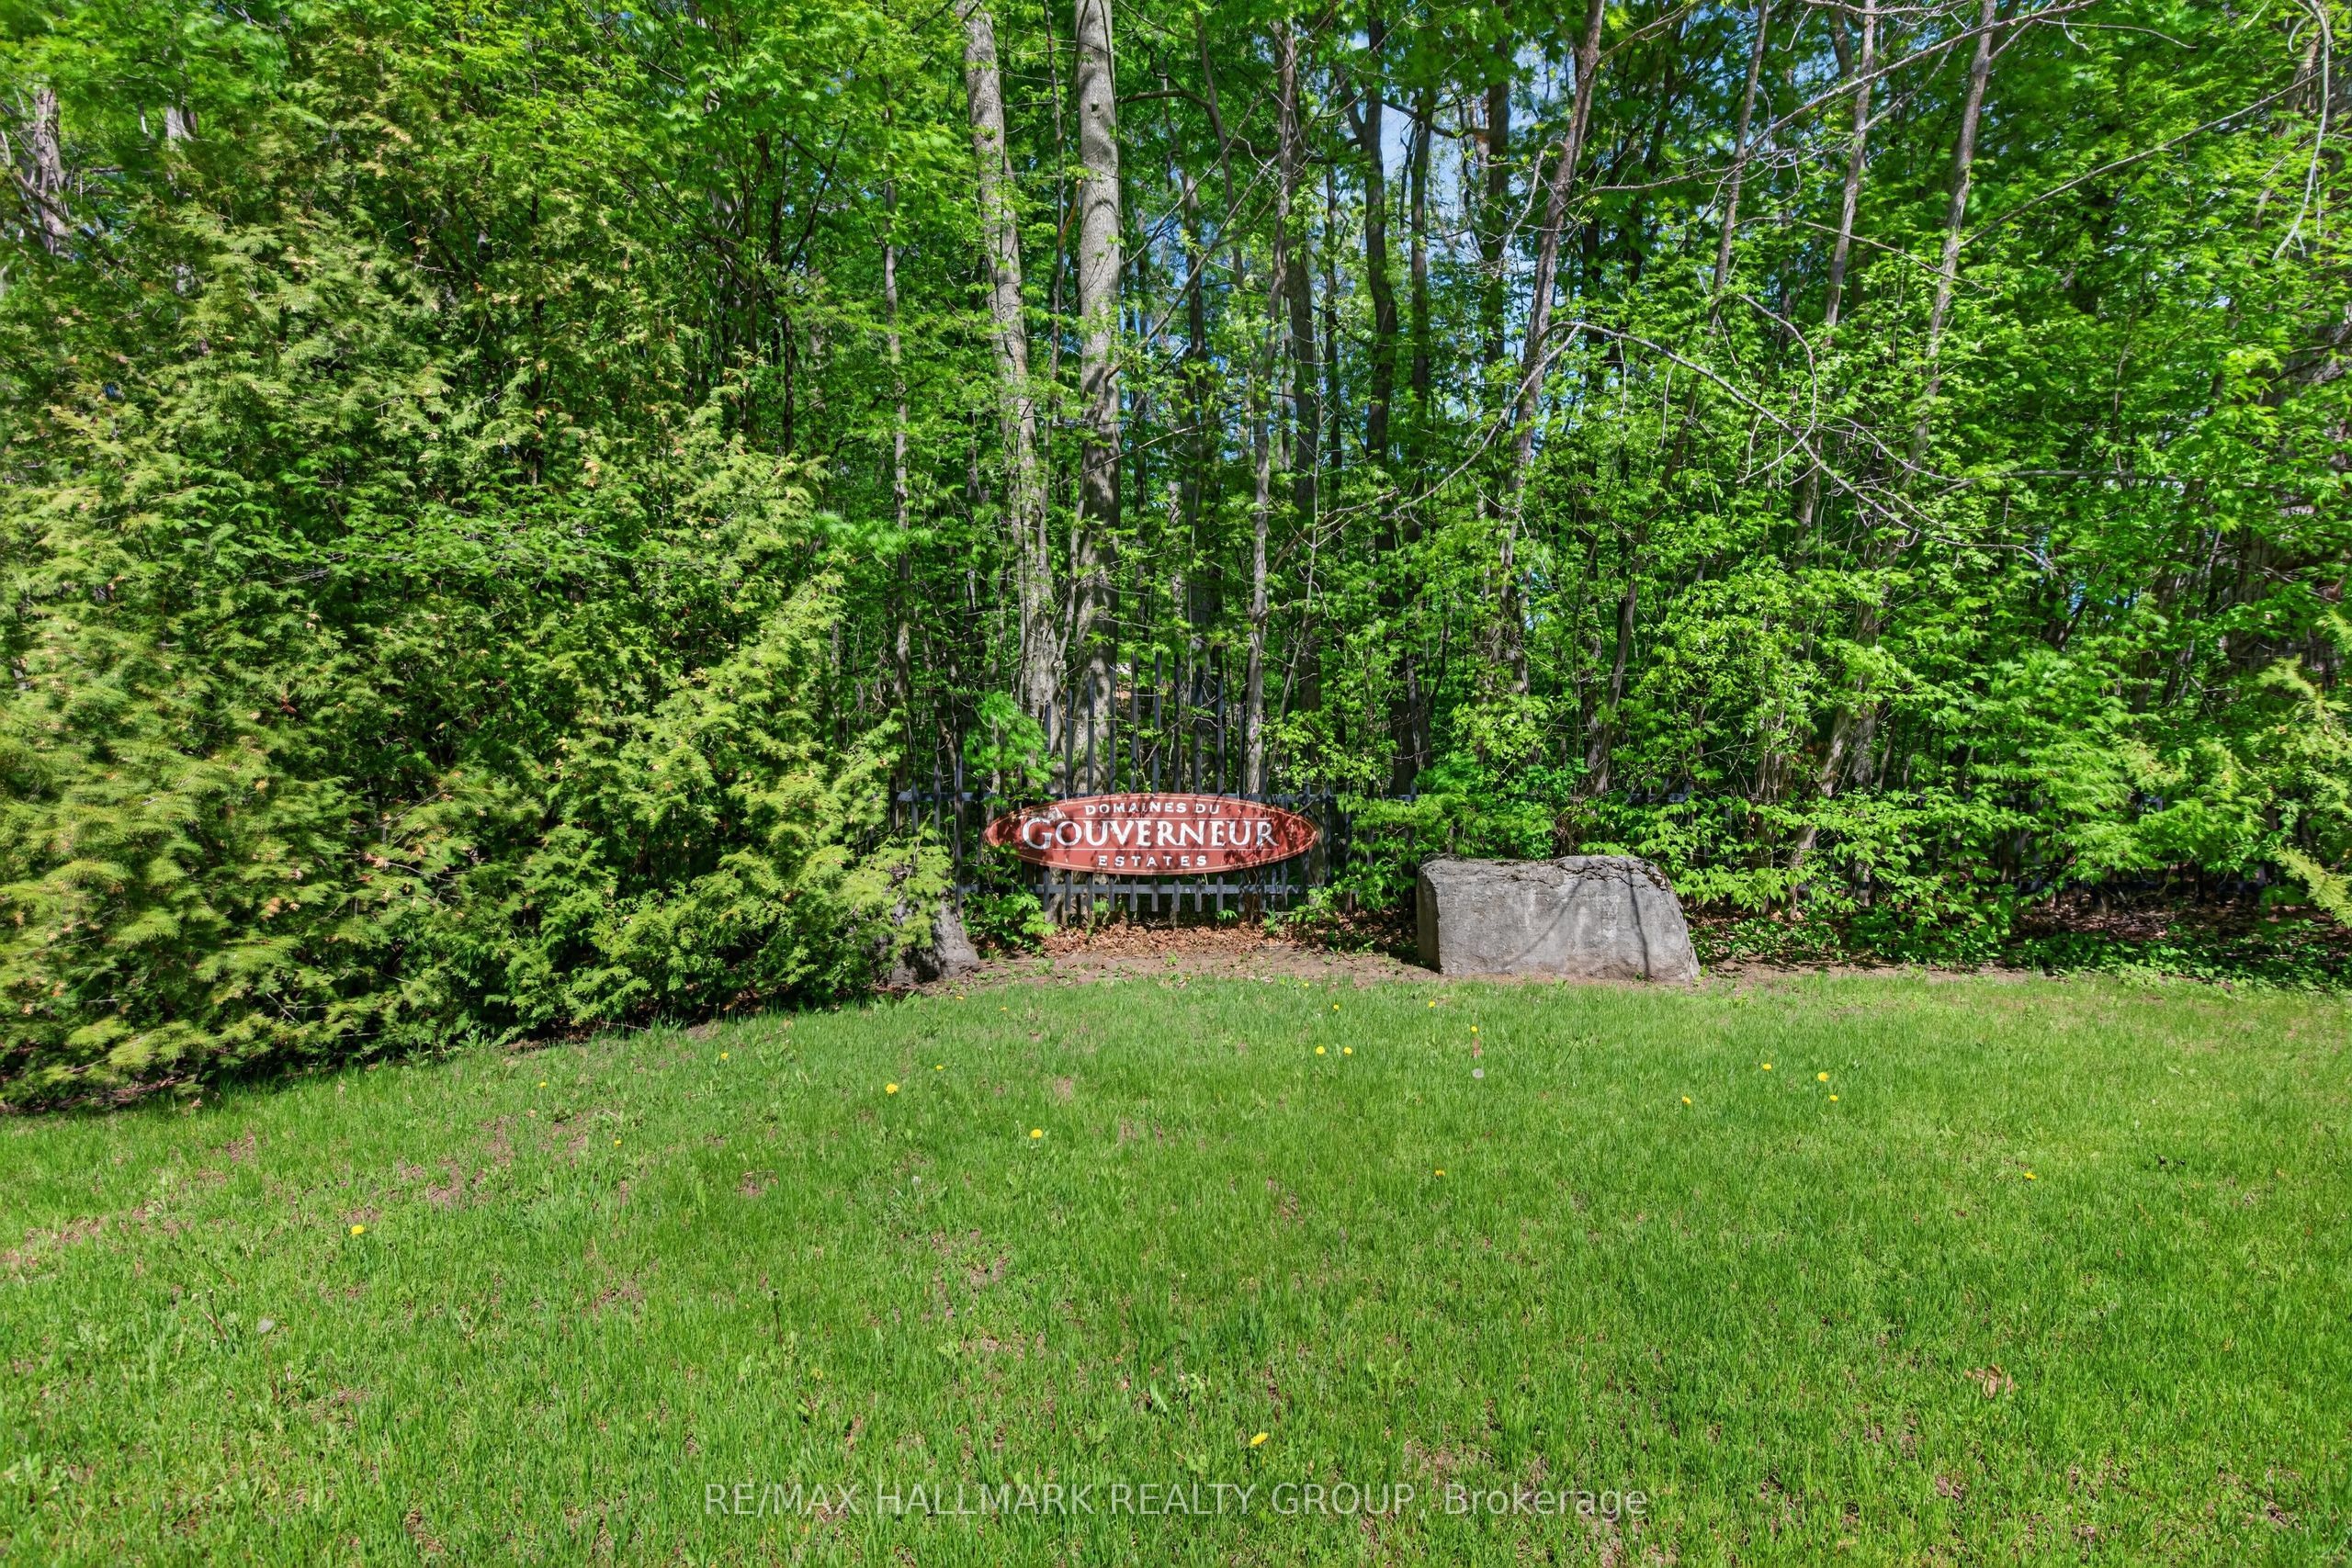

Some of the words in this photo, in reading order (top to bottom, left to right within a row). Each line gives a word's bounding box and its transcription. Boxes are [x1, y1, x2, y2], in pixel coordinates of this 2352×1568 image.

[1084, 802, 1187, 817] DOMAINES
[1195, 802, 1220, 815] DU
[1022, 817, 1279, 850] GOUVERNEUR
[1098, 854, 1208, 867] ESTATES
